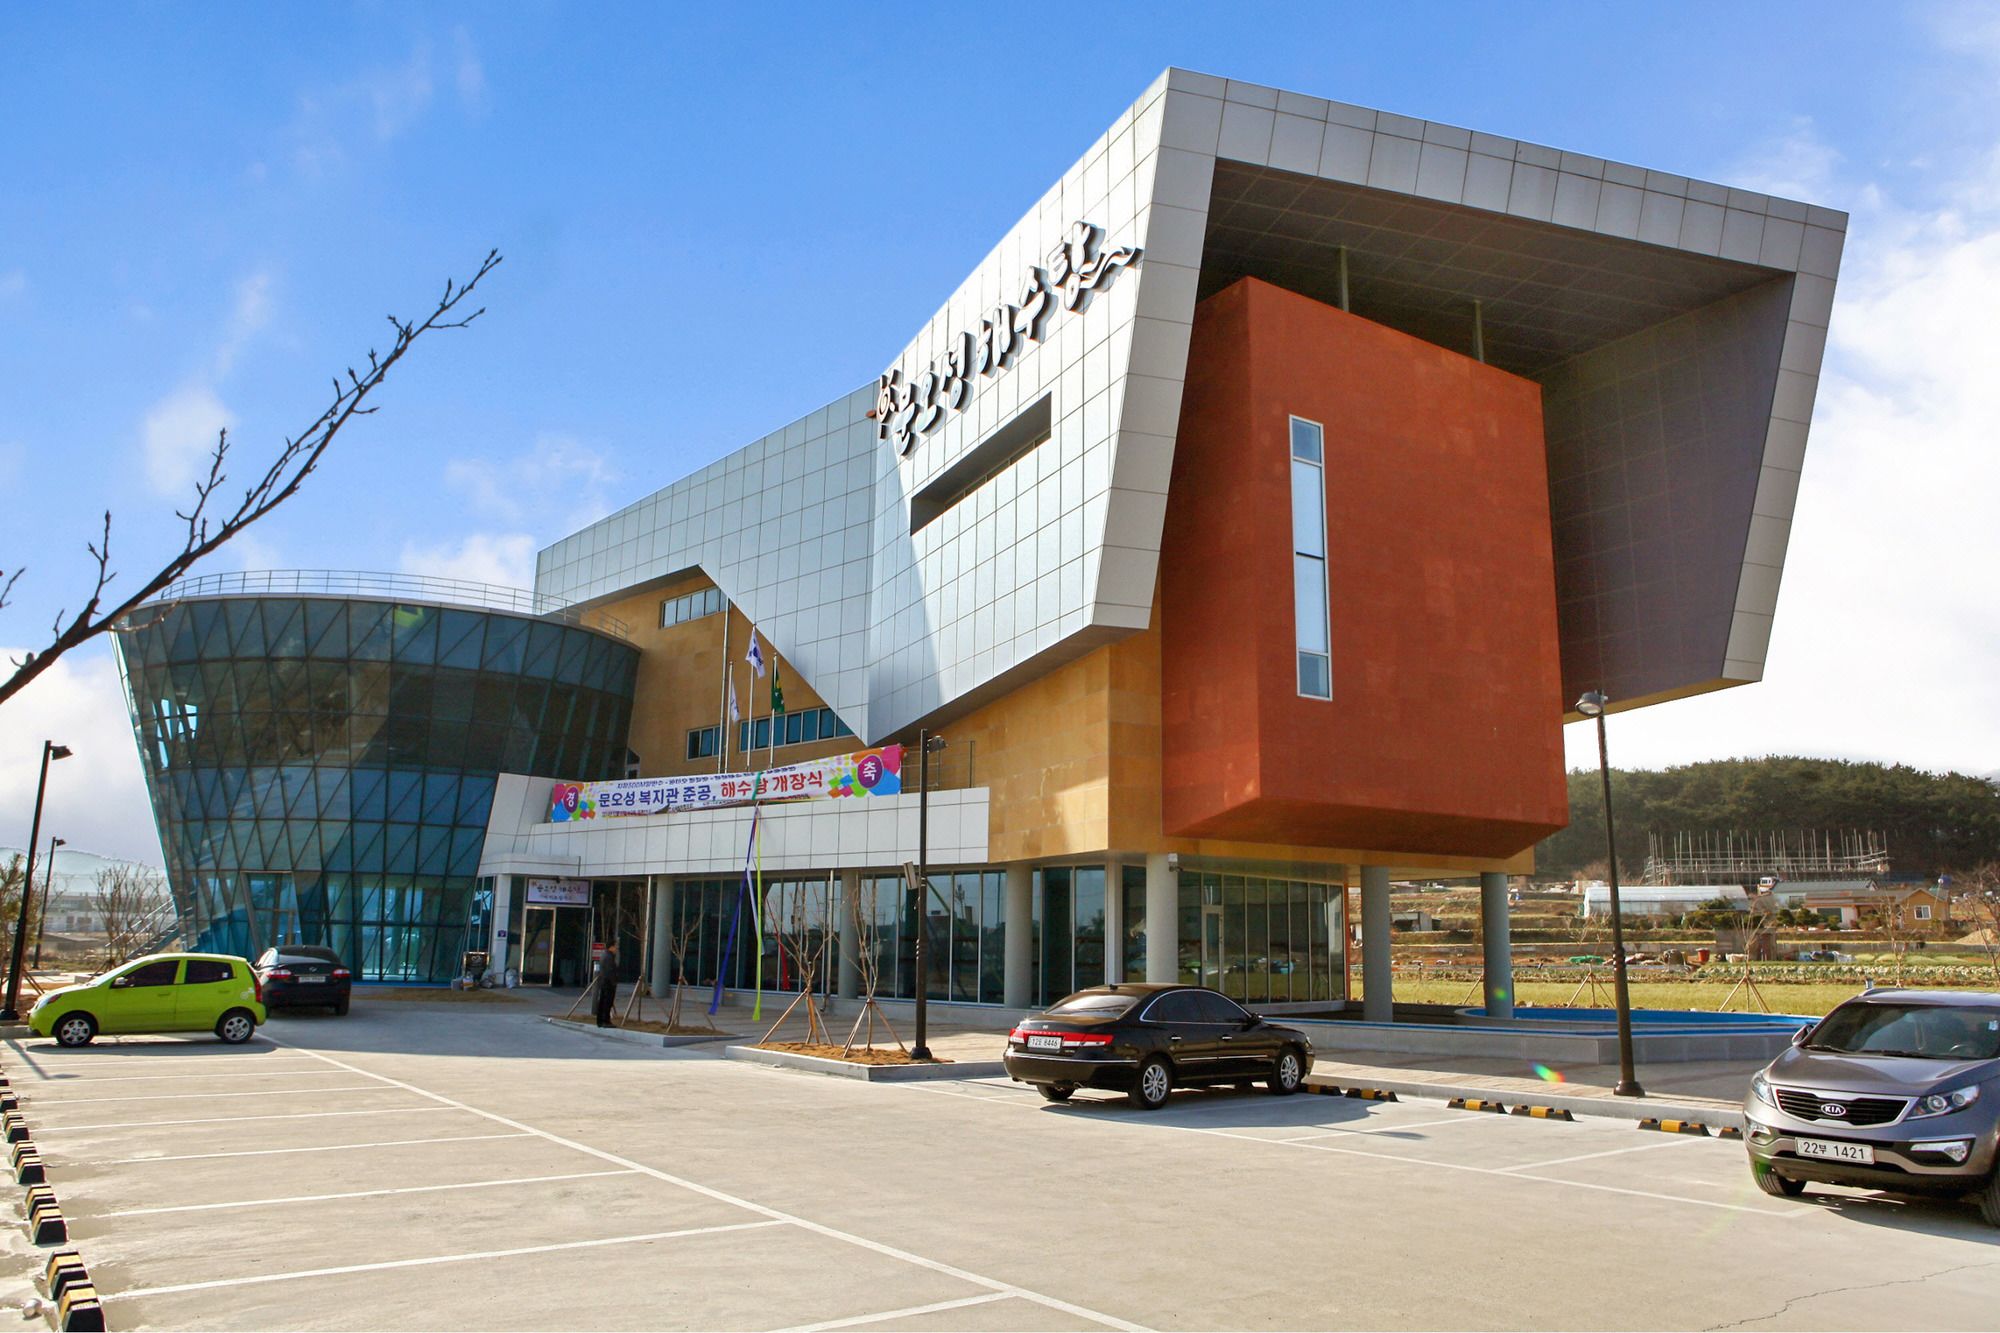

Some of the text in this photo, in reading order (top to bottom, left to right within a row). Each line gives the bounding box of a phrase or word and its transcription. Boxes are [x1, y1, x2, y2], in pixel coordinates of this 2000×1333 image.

[862, 761, 877, 781] 축
[599, 791, 636, 807] 문오성
[639, 787, 679, 805] 복지관
[682, 784, 716, 803] 준공,
[772, 770, 823, 793] 개장식
[1825, 1106, 1842, 1114] KIA
[1803, 1141, 1865, 1159] 22부 1421
